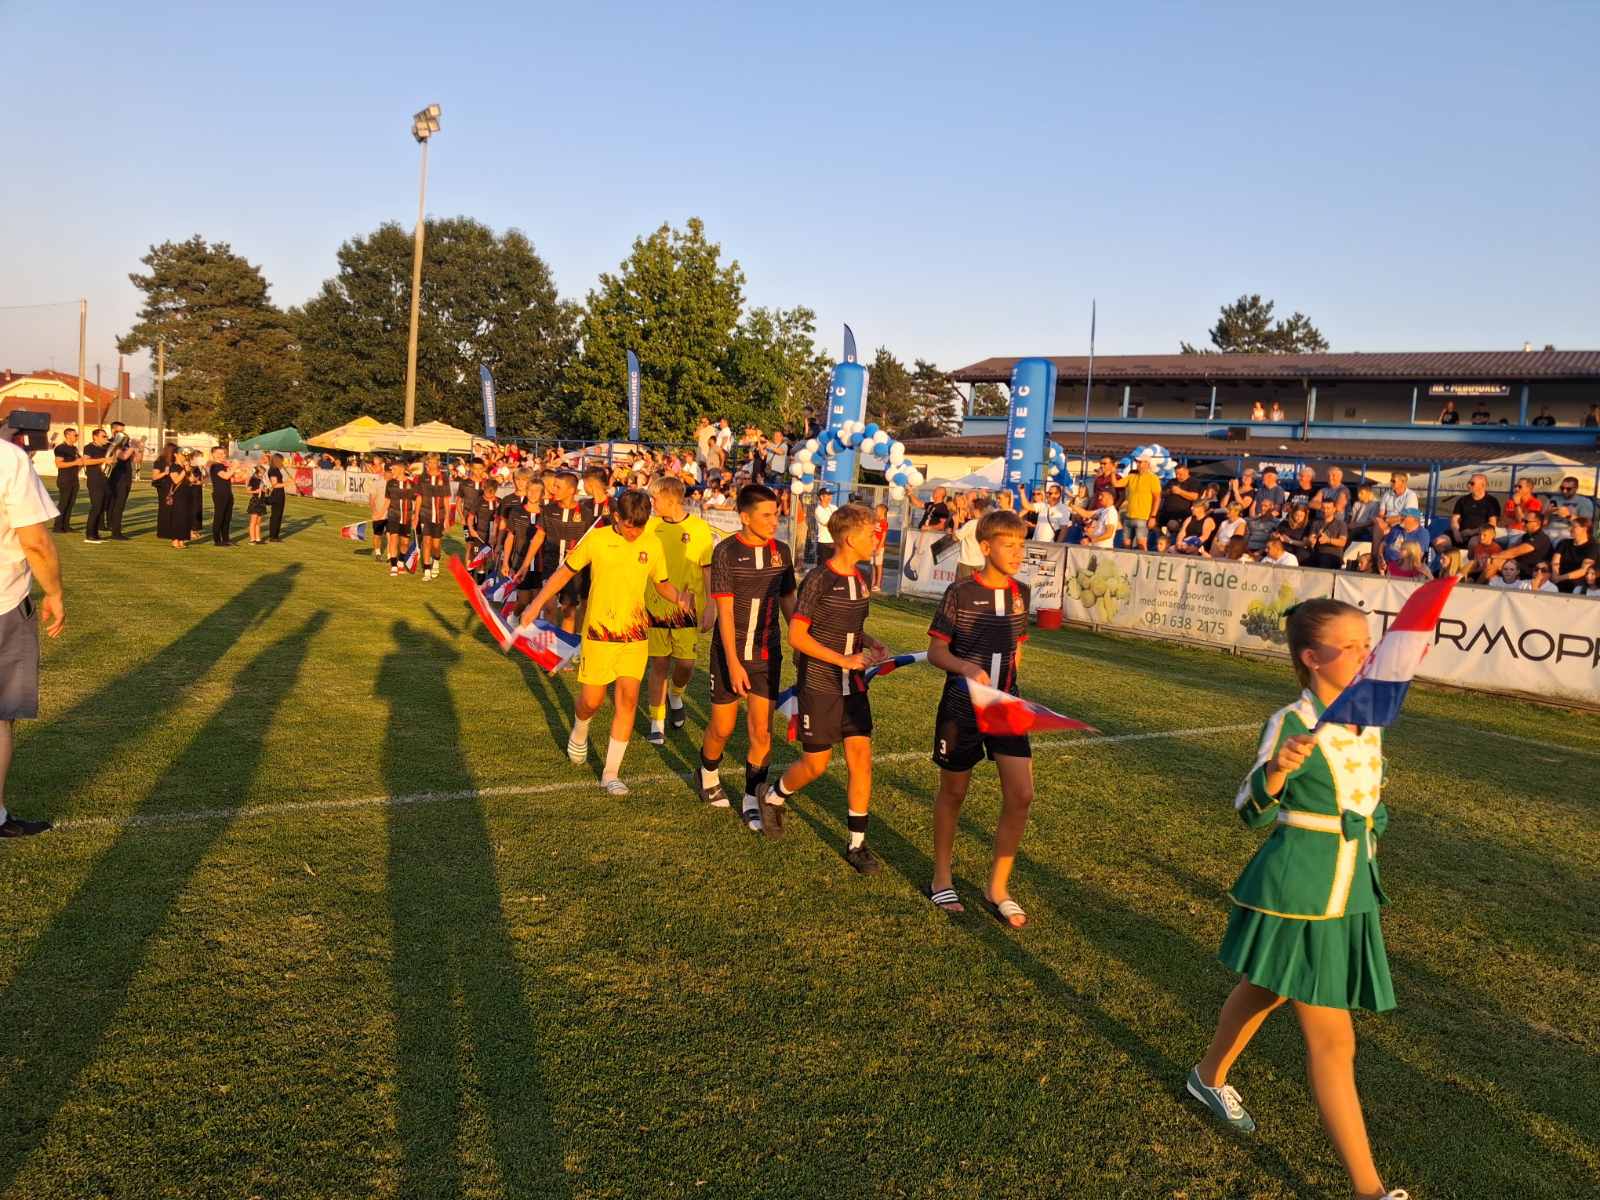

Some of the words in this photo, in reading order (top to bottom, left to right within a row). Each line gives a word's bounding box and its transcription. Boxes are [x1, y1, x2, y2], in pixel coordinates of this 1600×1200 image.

[1010, 385, 1030, 484] MUREC
[1185, 564, 1238, 590] Trade
[1145, 611, 1167, 626] 091
[1170, 615, 1192, 630] 638
[1196, 619, 1225, 635] 2175
[1198, 605, 1233, 617] trgovina
[1373, 609, 1600, 669] TRMOP
[940, 739, 947, 754] 3
